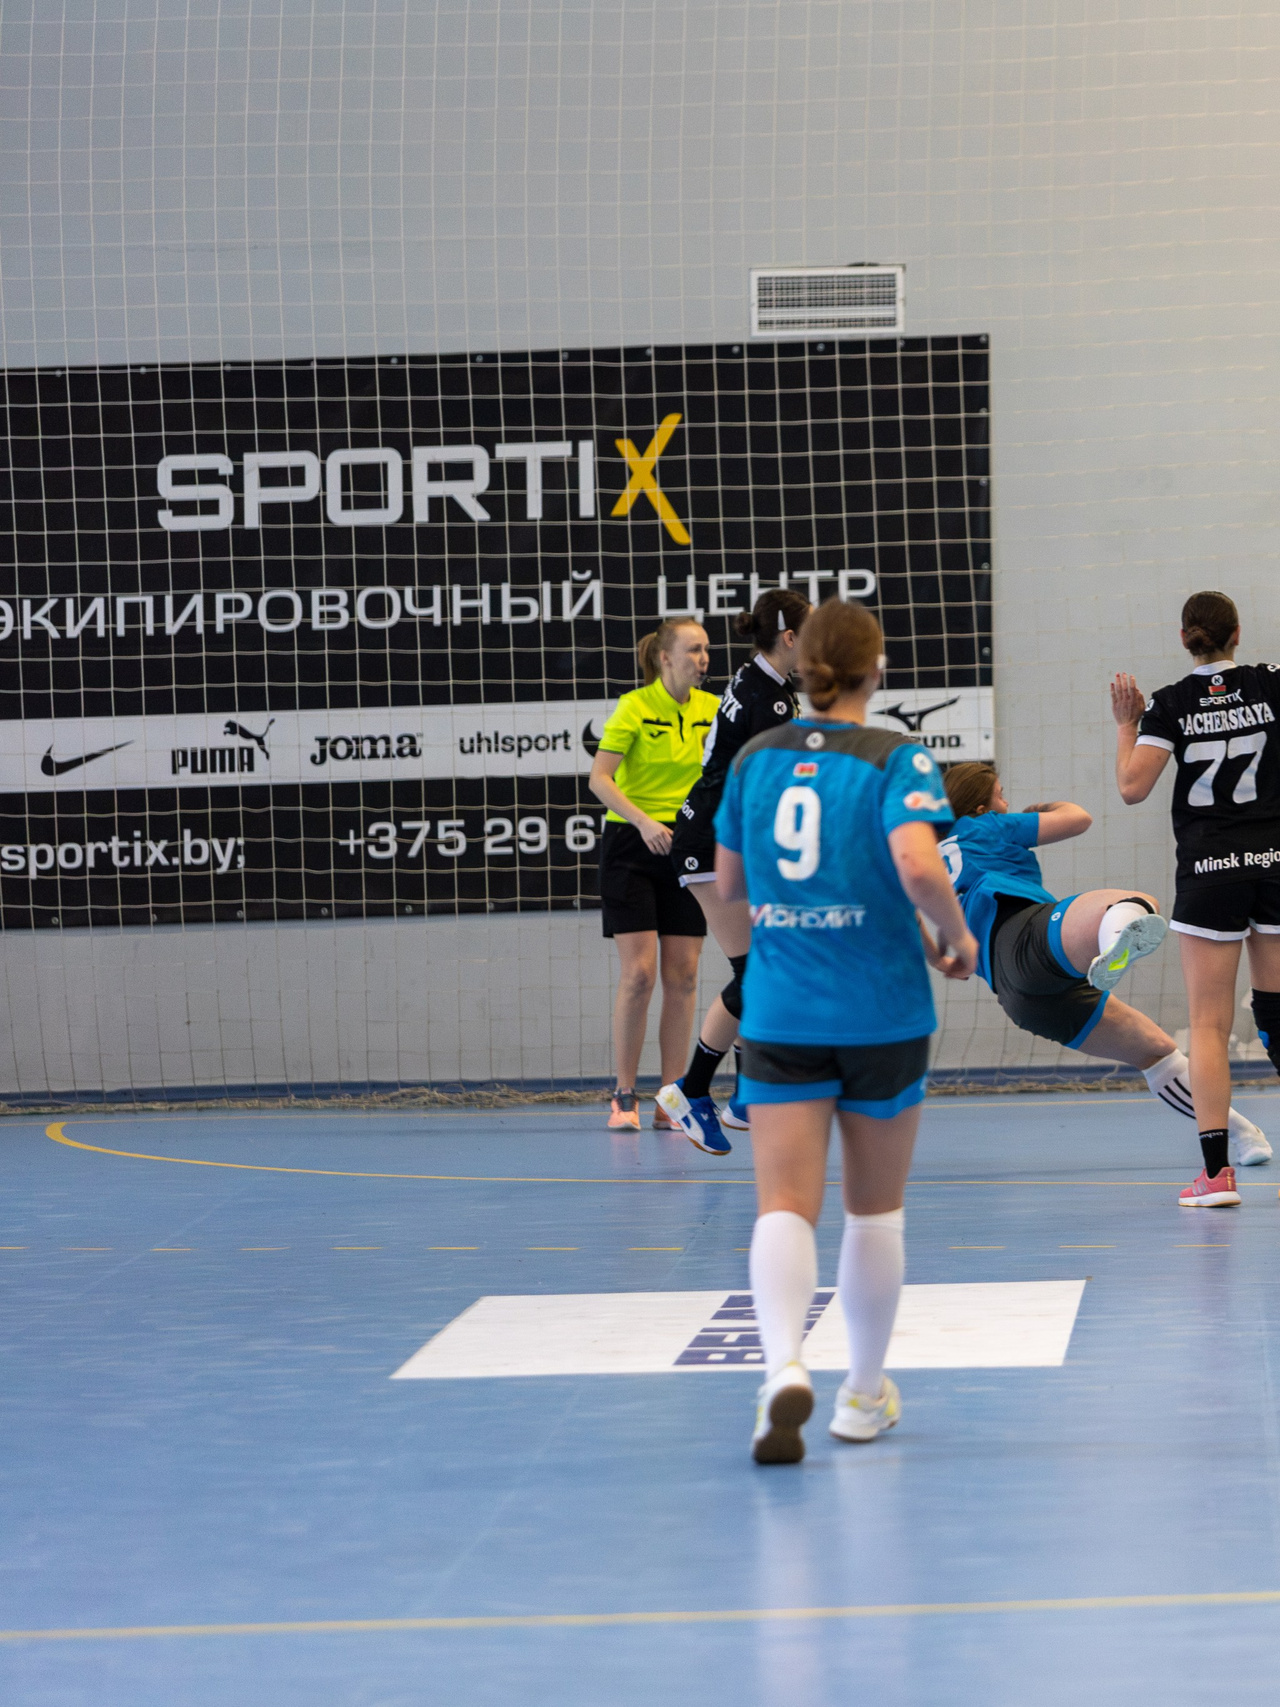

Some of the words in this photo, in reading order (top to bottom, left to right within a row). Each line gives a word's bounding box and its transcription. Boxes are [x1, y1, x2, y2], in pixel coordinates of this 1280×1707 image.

[156, 412, 692, 545] SPORTIX
[1199, 688, 1244, 707] SPORTIX
[171, 747, 254, 775] PUMA
[459, 730, 571, 758] uhlsport
[1183, 731, 1268, 807] 77
[0, 828, 246, 880] sportix.by;
[338, 818, 468, 860] +375
[483, 815, 549, 856] 29
[564, 813, 606, 853] 6
[773, 785, 822, 881] 9
[1194, 852, 1240, 875] Minsk
